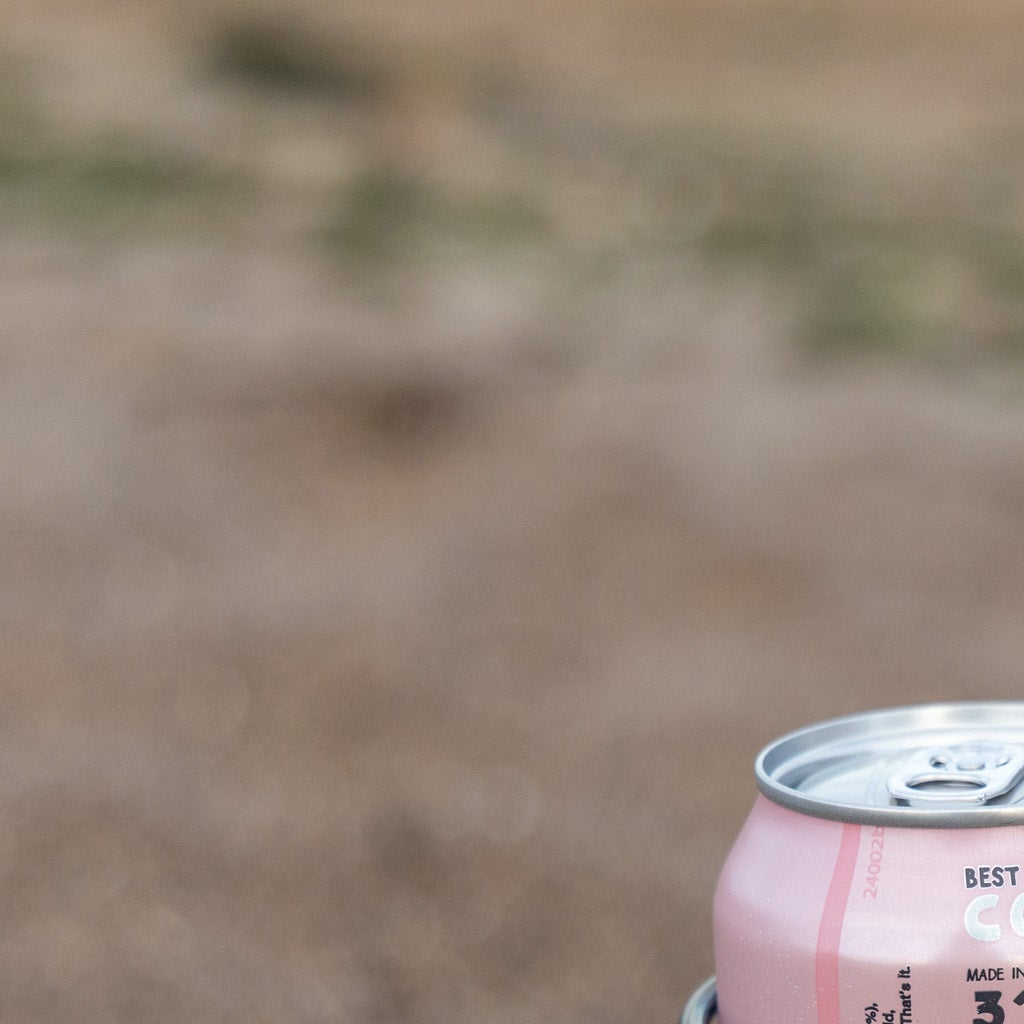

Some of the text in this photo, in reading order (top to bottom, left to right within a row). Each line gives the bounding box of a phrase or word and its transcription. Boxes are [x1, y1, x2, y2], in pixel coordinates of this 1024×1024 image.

[964, 866, 1020, 889] BEST
[966, 968, 1005, 982] MADE
[899, 983, 913, 1024] That's
